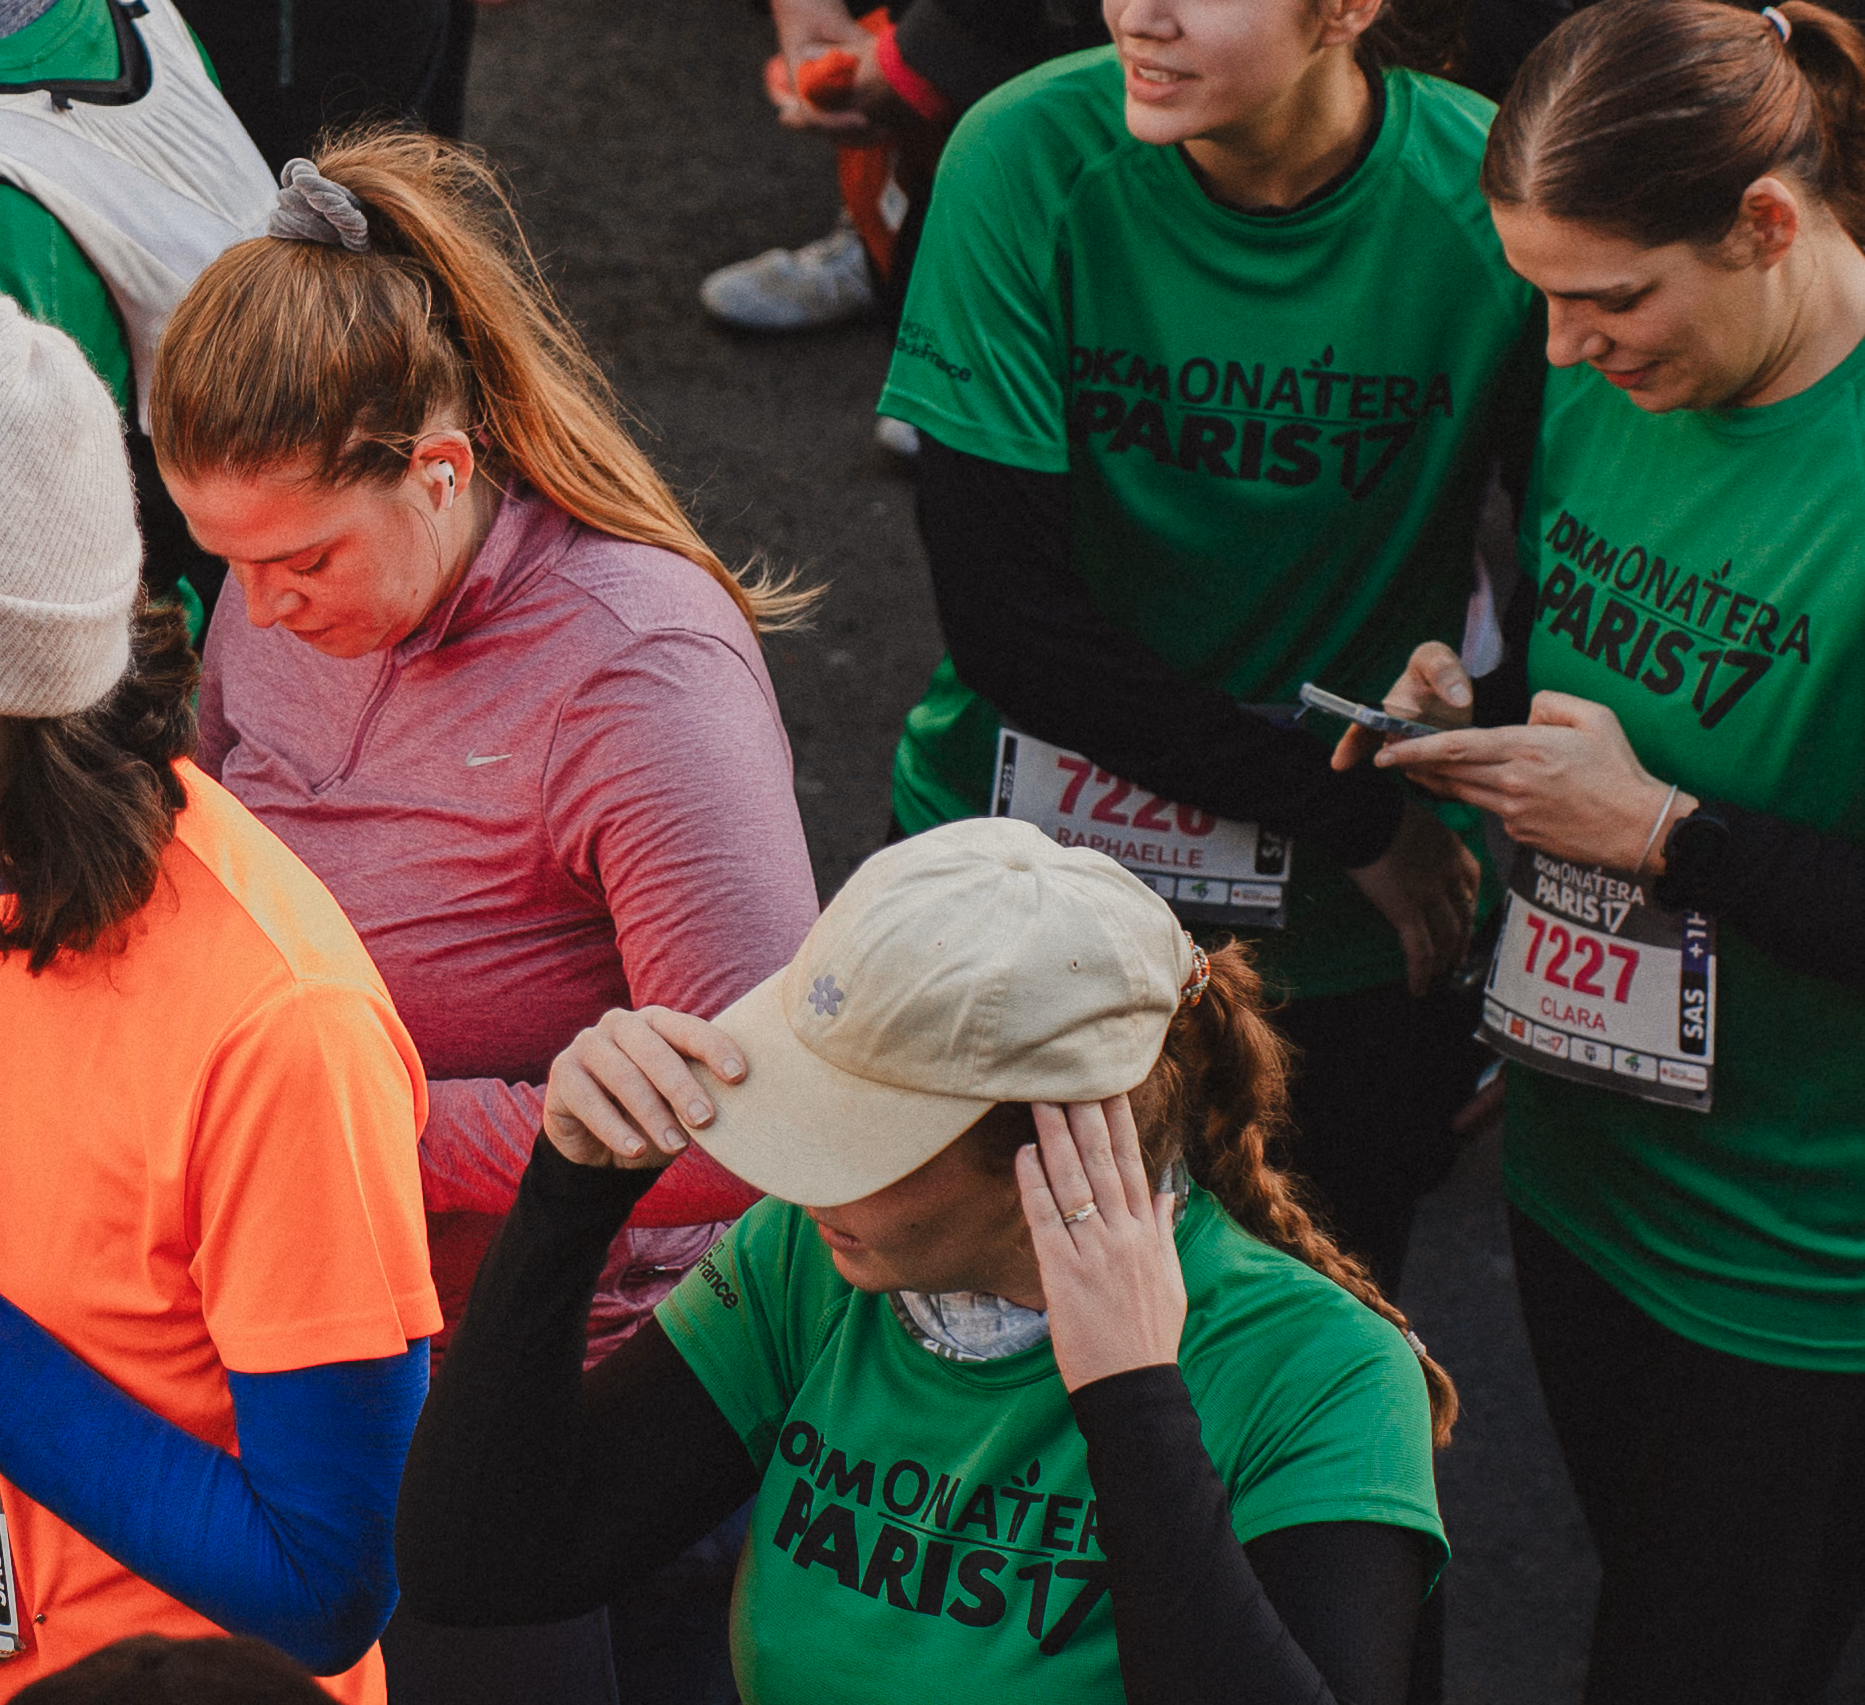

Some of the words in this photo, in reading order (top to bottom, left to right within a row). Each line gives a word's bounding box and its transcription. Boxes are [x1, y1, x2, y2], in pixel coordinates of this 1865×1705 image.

[1535, 562, 1774, 730] PARIS17
[1055, 827, 1204, 870] RAPHAELLE
[1535, 874, 1631, 934] PARIS17
[1524, 912, 1640, 1004] 7227
[1539, 995, 1607, 1033] CLARA
[1684, 988, 1706, 1040] SAS
[772, 1476, 1110, 1657] PARIS17
